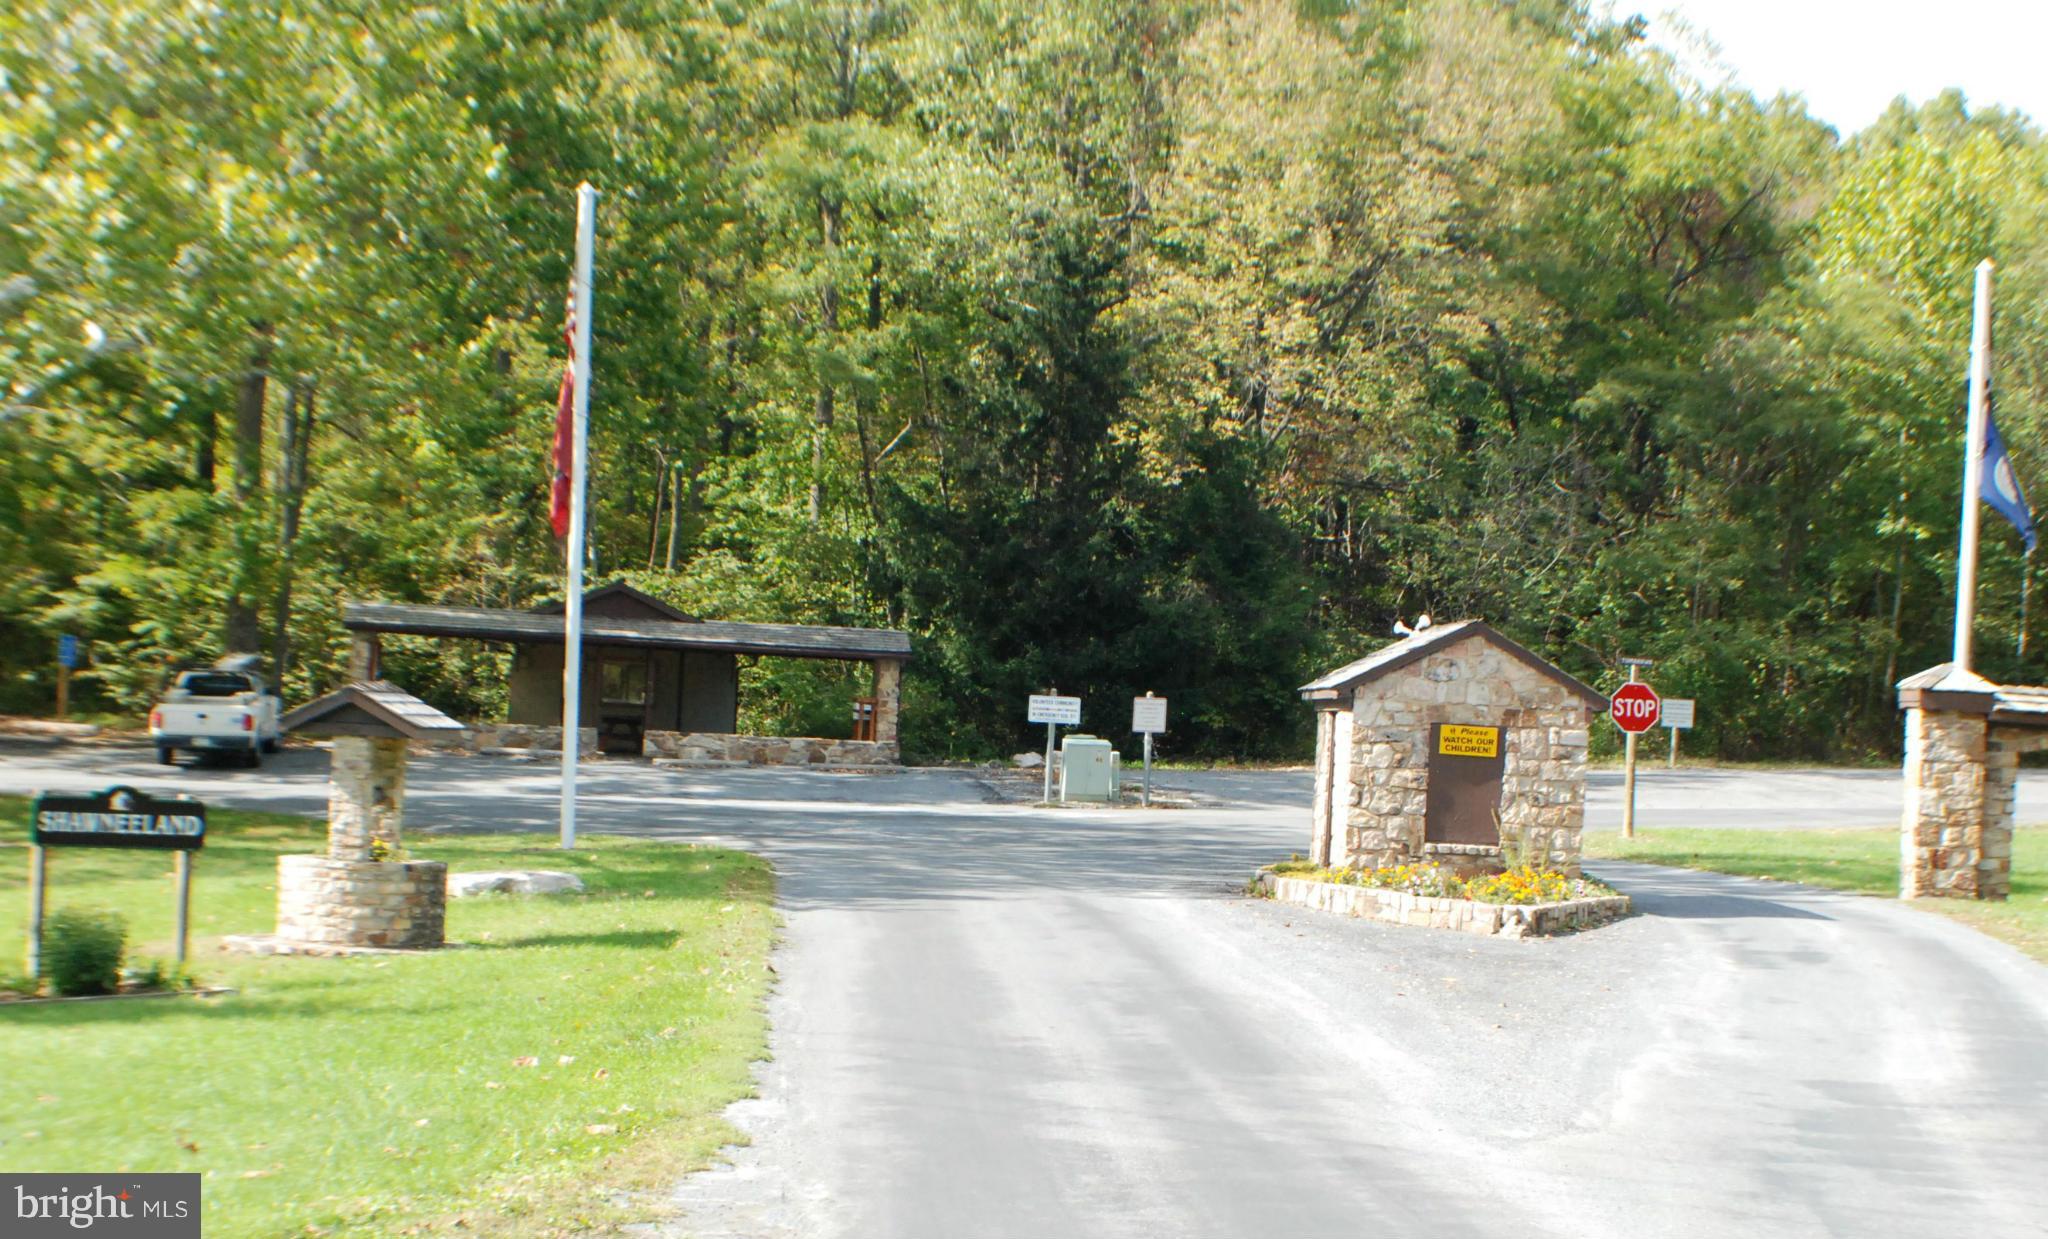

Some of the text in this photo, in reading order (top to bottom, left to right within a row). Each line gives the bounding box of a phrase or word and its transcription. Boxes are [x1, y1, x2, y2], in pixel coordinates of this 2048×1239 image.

[1614, 698, 1656, 718] STOP
[1461, 728, 1489, 736] Please
[1443, 736, 1472, 744] WATCH
[1445, 744, 1492, 753] CHILDREN!
[37, 810, 204, 836] SHAWNEELAND
